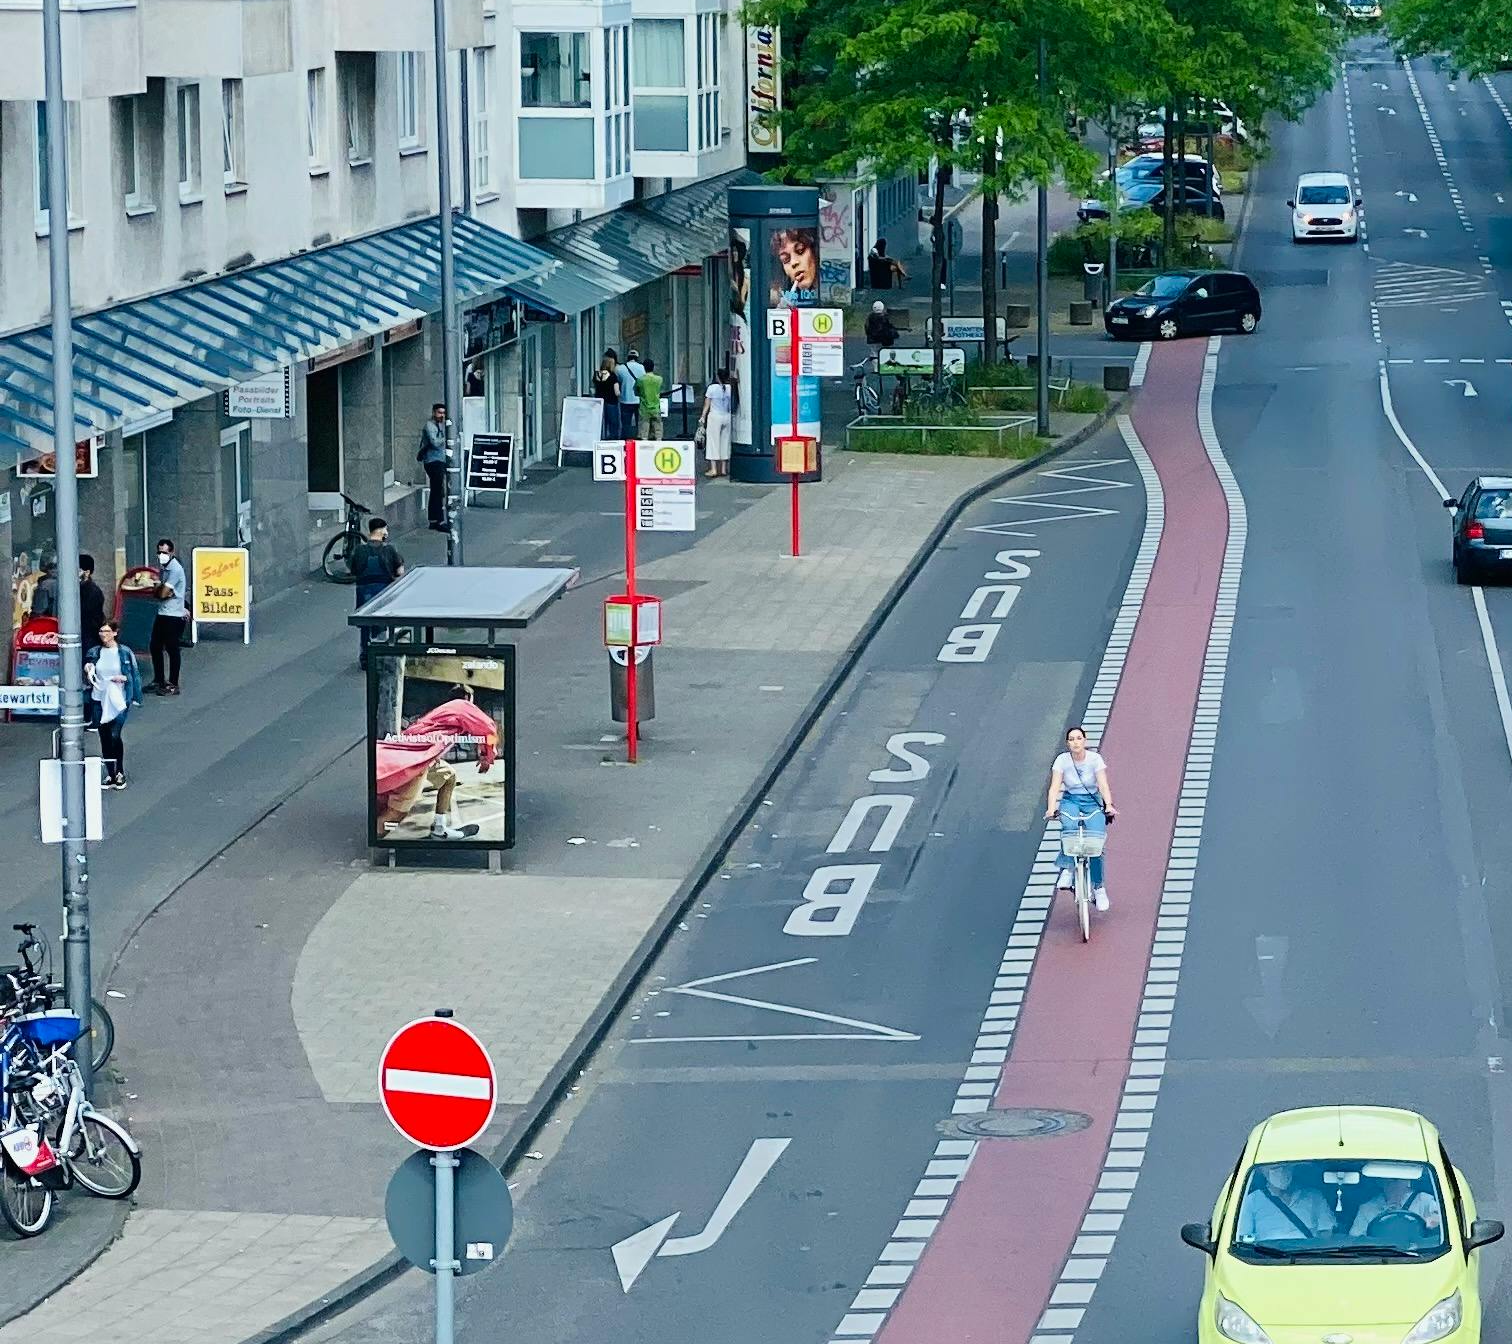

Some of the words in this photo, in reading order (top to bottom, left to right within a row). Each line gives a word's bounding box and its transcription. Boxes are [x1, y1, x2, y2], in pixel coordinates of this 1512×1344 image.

[751, 24, 777, 146] Clifornia
[773, 319, 785, 336] B
[818, 317, 828, 330] H
[238, 395, 276, 404] Portraits
[601, 454, 617, 475] B
[661, 452, 674, 468] H
[204, 585, 239, 597] Pass-
[200, 601, 243, 614] Bilder
[937, 549, 1042, 663] BUS
[782, 731, 947, 937] BUS
